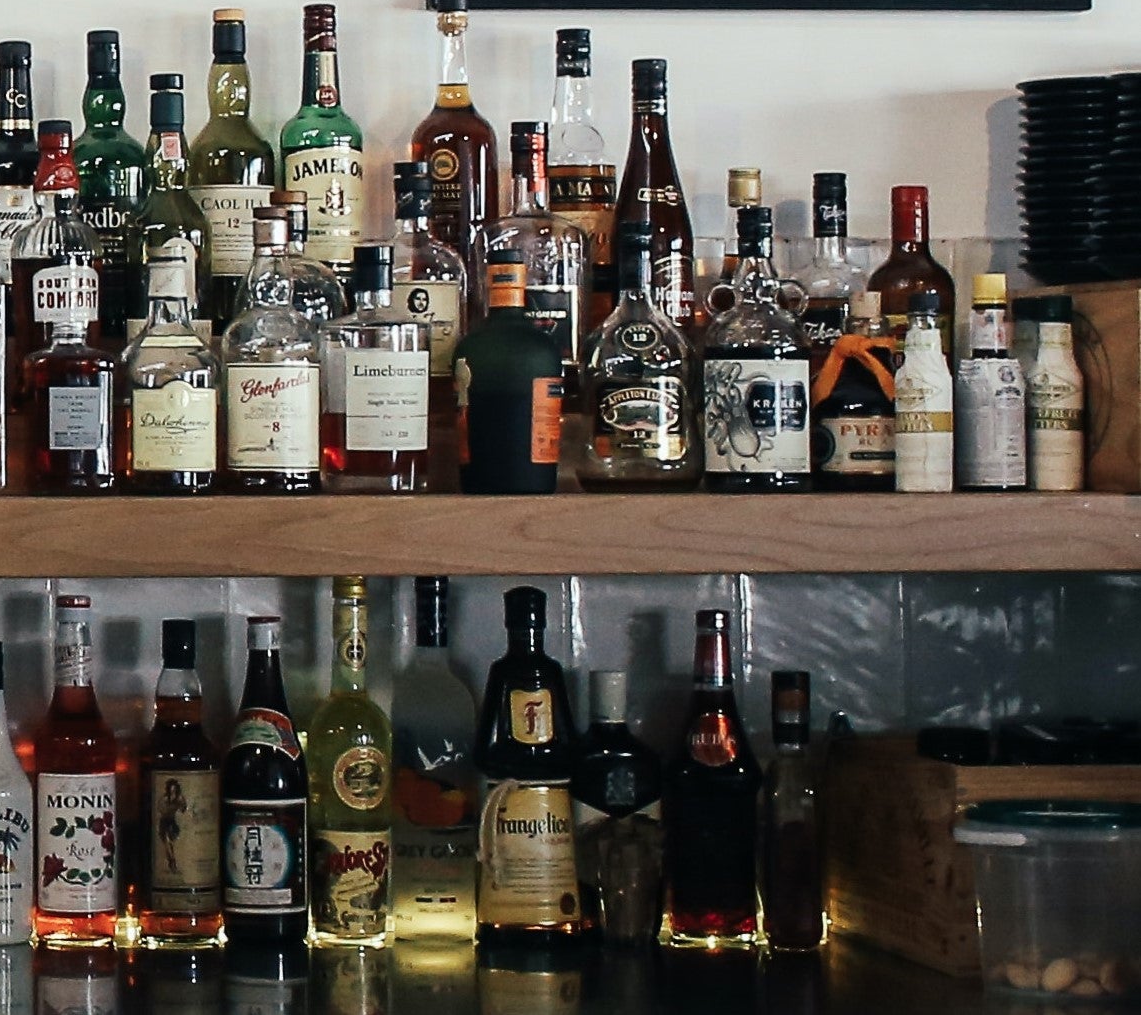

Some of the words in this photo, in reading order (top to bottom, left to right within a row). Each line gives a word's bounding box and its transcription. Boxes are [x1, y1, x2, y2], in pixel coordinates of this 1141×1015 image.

[201, 197, 241, 210] CAOL
[227, 217, 240, 229] 12
[272, 421, 281, 433] 8
[46, 794, 114, 809] MONIN
